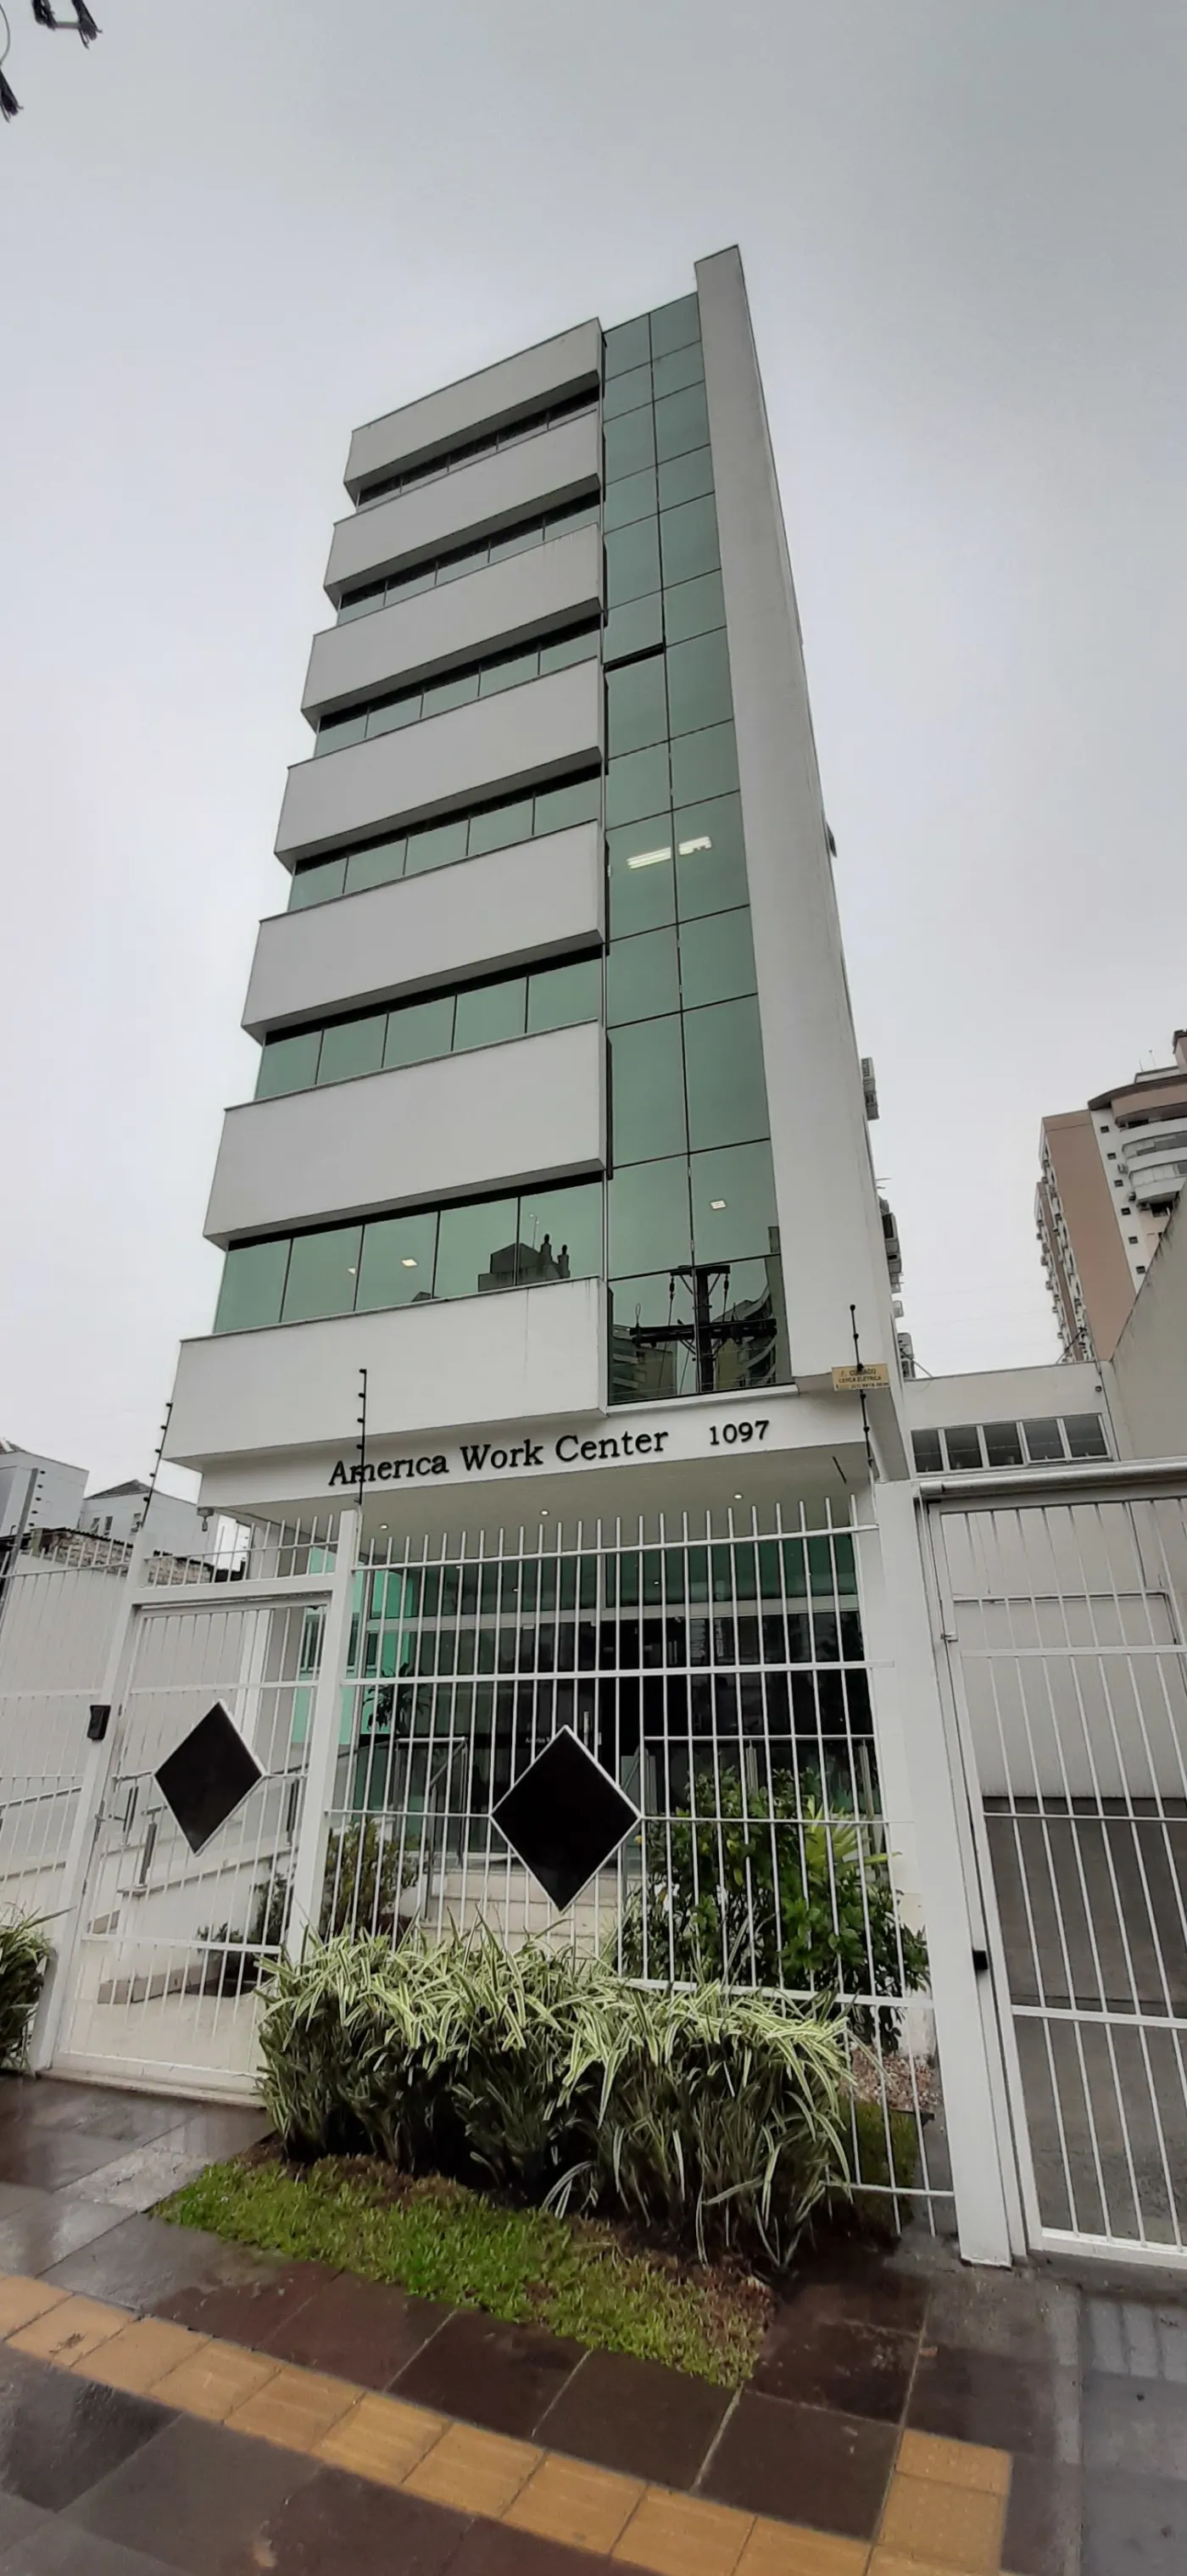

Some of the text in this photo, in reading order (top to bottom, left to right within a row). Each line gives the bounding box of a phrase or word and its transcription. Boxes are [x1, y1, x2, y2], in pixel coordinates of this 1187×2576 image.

[329, 1419, 770, 1486] America Work Center 1097
